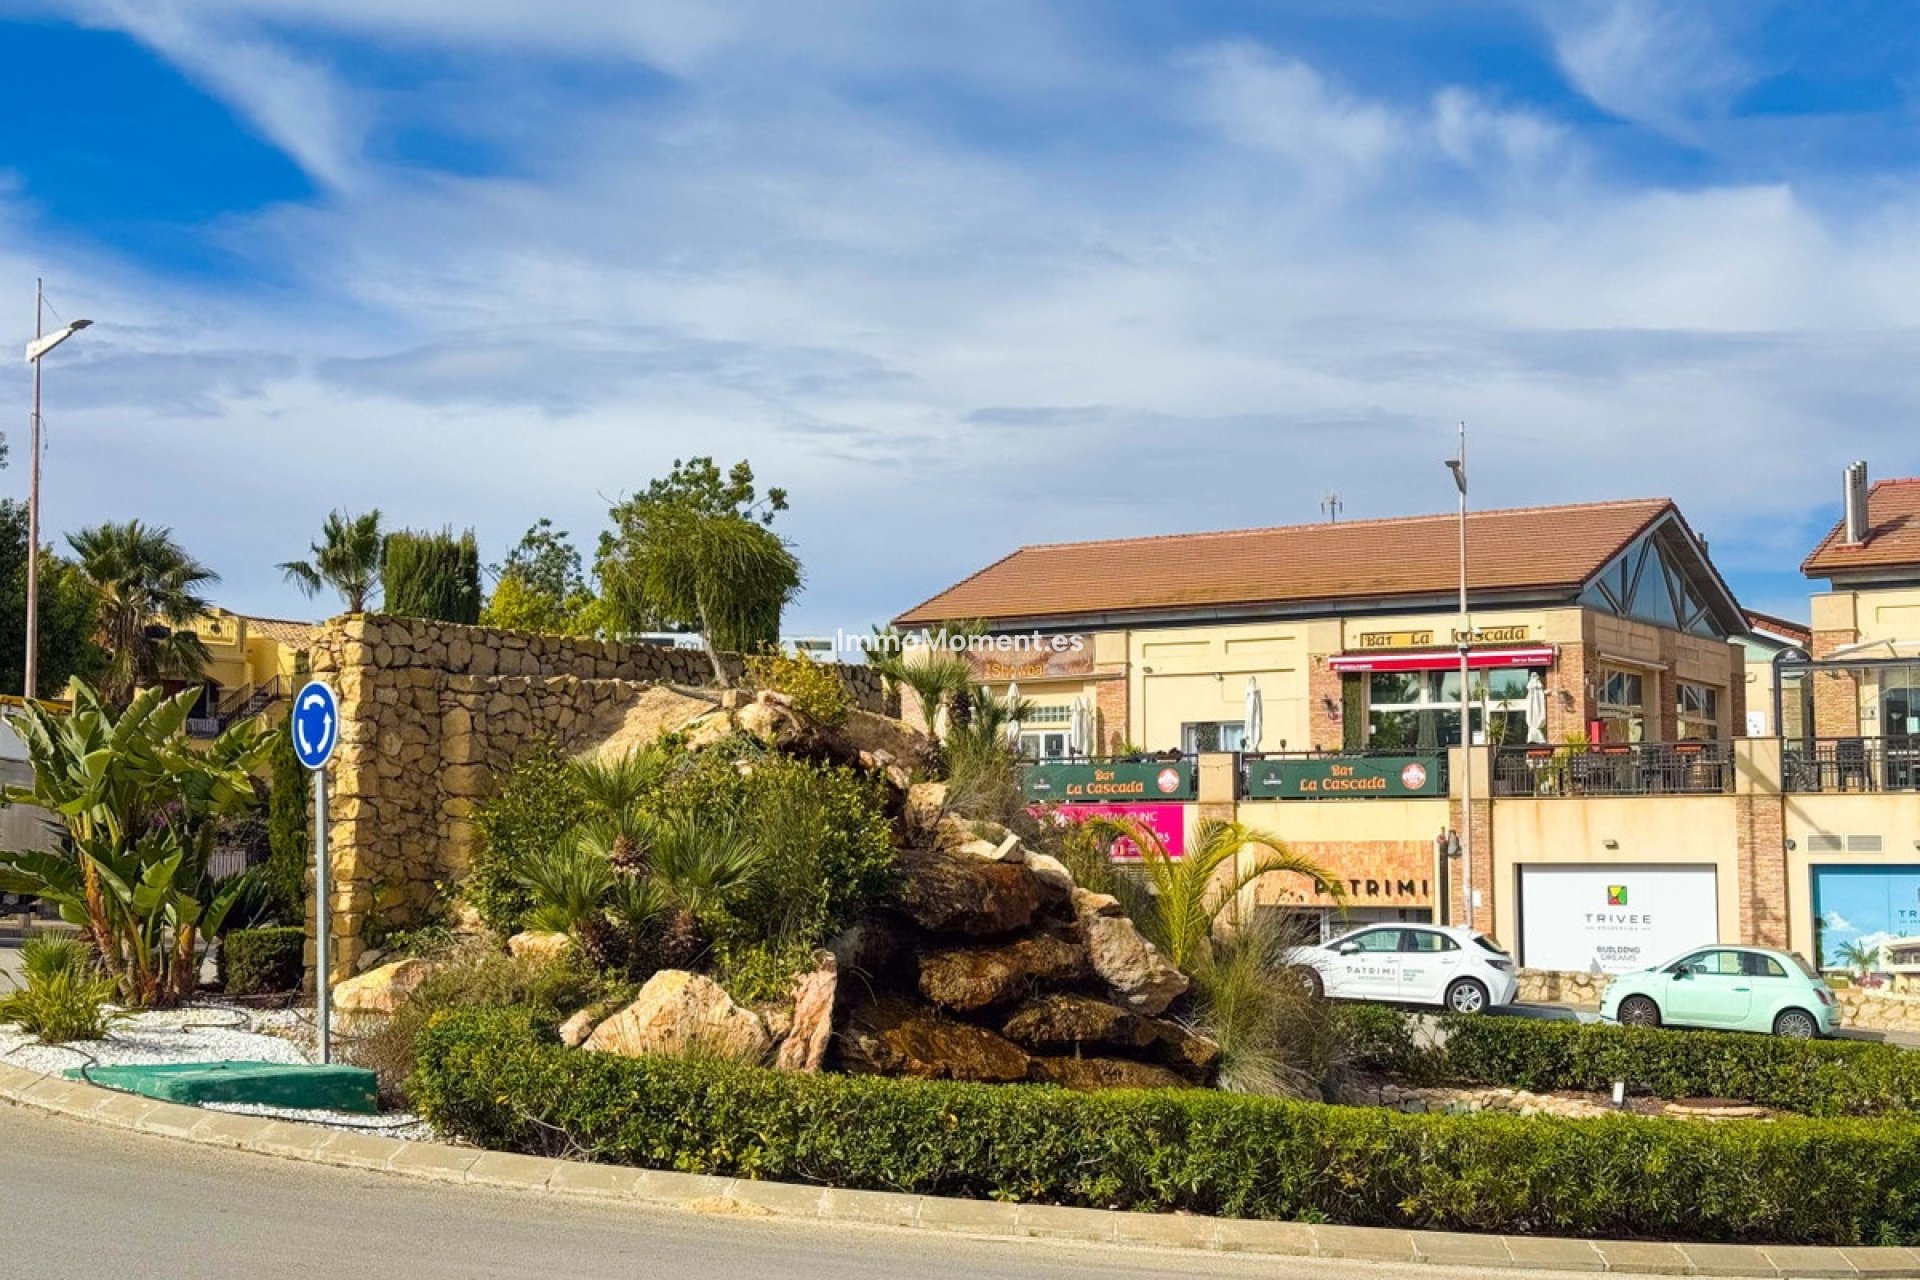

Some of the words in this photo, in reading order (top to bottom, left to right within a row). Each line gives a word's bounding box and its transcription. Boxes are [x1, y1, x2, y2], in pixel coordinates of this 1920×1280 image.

[1364, 633, 1393, 647] Bar
[1410, 632, 1430, 645] La
[1094, 769, 1115, 781] Bar
[1330, 764, 1354, 777] Bar
[1066, 783, 1083, 795] La
[1086, 780, 1145, 794] Cascada
[1299, 778, 1318, 791] La
[1322, 776, 1386, 791] Cascada
[1584, 913, 1652, 924] TRIVEE
